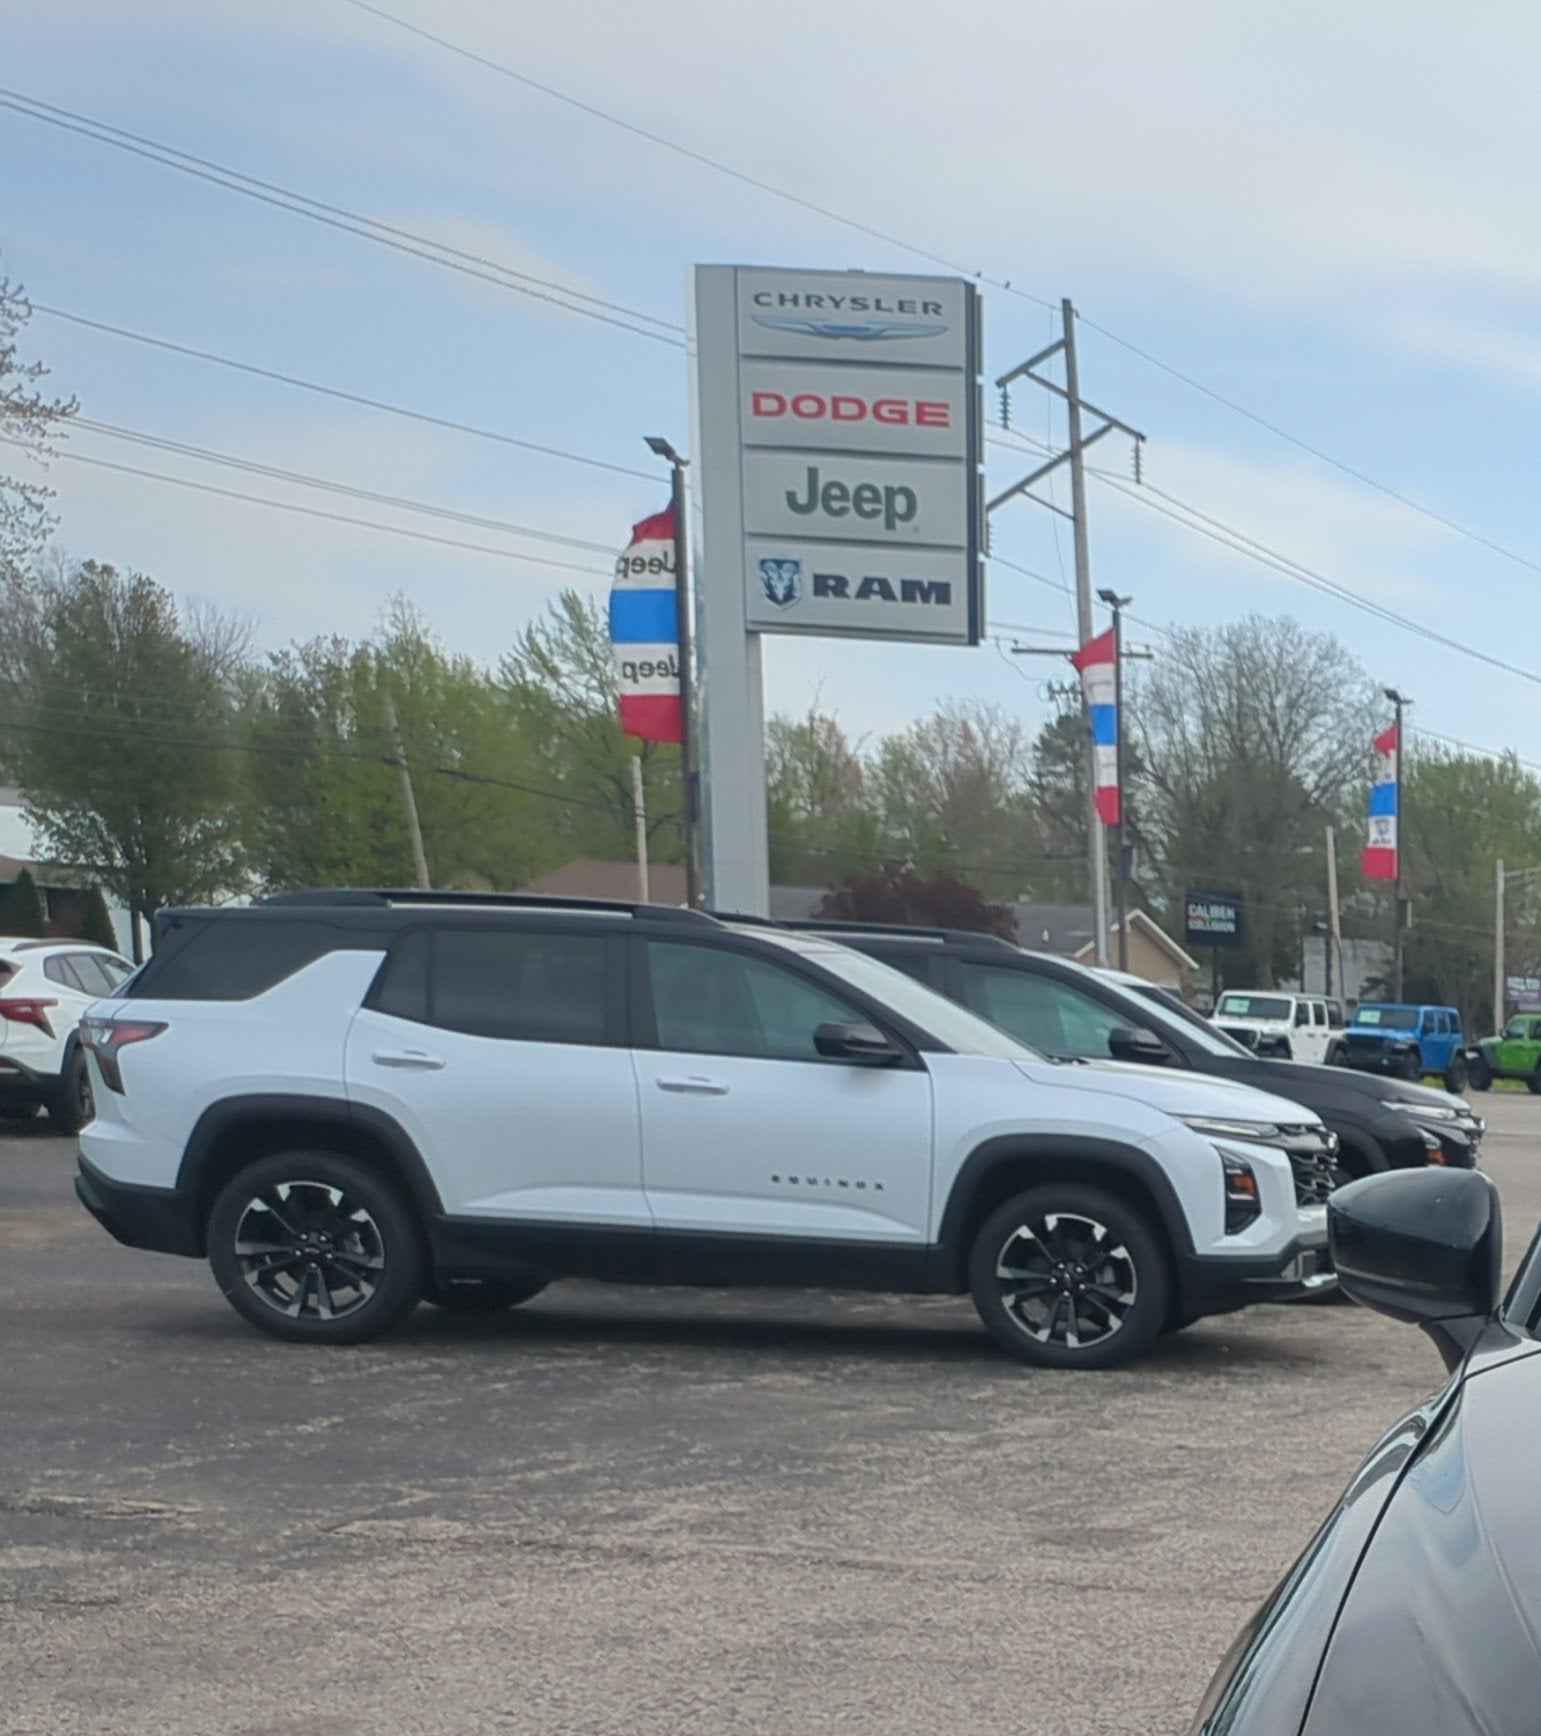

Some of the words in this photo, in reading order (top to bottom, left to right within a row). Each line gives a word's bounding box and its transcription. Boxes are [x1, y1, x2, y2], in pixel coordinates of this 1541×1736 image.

[753, 291, 944, 317] CHRYSLER
[752, 391, 950, 428] DODGE
[785, 466, 918, 531] Jeep
[812, 573, 952, 606] RAM
